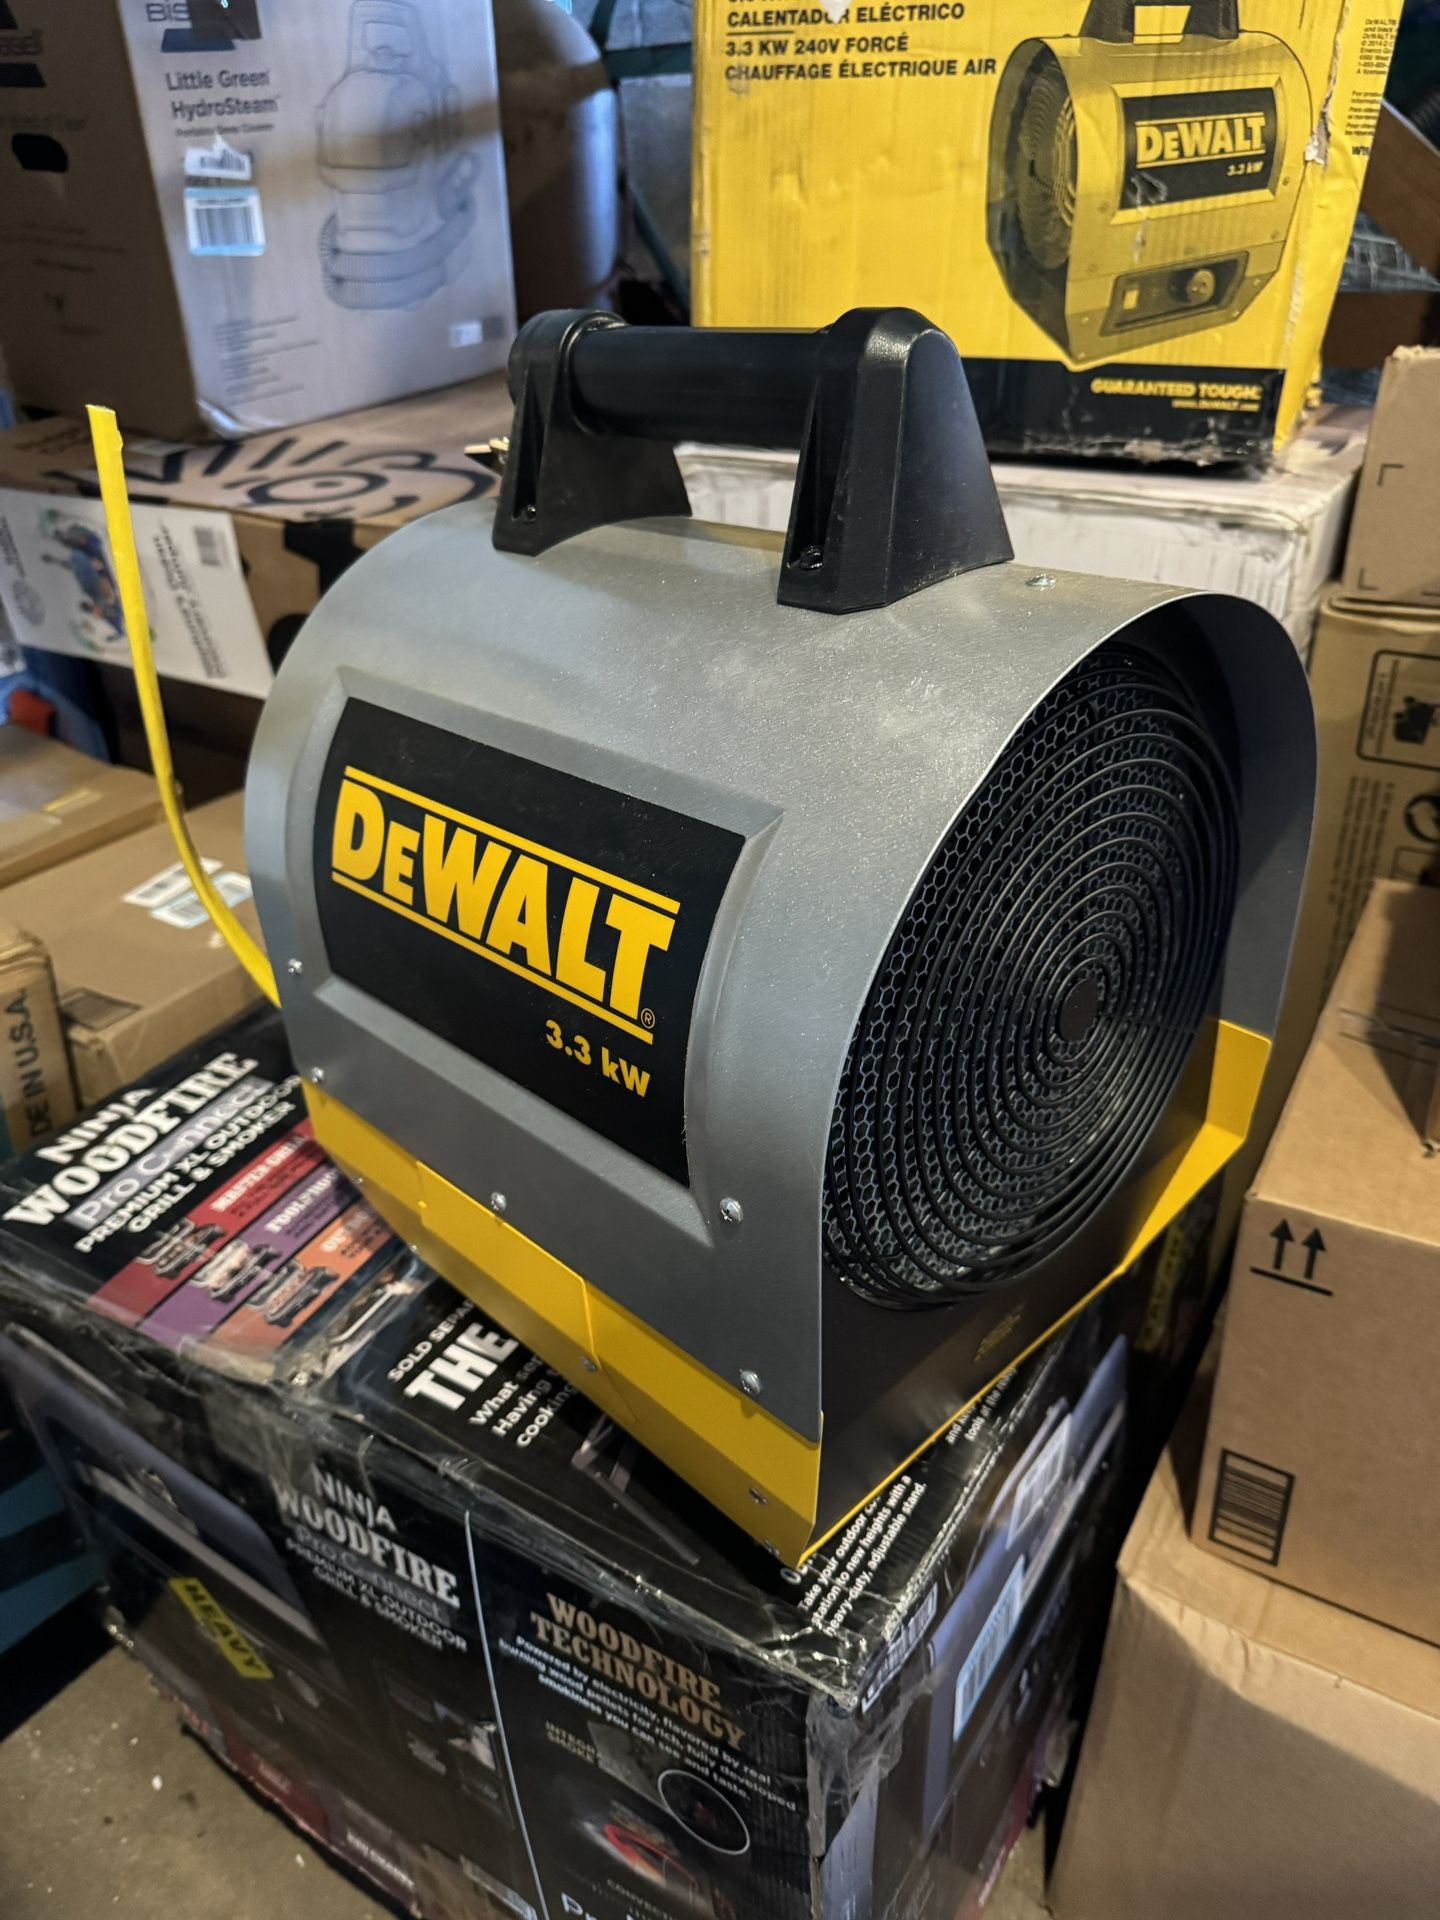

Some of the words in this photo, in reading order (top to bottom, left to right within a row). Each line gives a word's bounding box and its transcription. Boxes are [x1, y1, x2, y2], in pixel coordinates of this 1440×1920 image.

[725, 41, 753, 56] 3.3
[759, 40, 788, 56] KW
[795, 38, 839, 55] 240V
[846, 32, 908, 53] FORCÉ
[857, 3, 965, 23] ELÉCTRICO
[166, 70, 213, 91] Little
[218, 69, 270, 88] Green
[725, 63, 832, 80] CHAUFFAGE
[839, 58, 957, 79] ÉLECTRIQUE
[964, 58, 996, 75] AIR
[172, 97, 279, 121] HydroSteam
[1091, 377, 1196, 398] GUARANTEED
[21, 1068, 46, 1098] IN
[545, 1019, 593, 1067] 3.3
[602, 1046, 651, 1098] kW
[3, 1052, 259, 1226] WOODFIRE
[35, 1087, 158, 1165] NINJA
[74, 1171, 180, 1253] PREMIUM
[174, 1150, 210, 1176] XL
[204, 1074, 302, 1150] OUTDOOR
[127, 1182, 197, 1233] GRILL
[208, 1100, 297, 1168] SMOKER
[75, 1177, 141, 1224] Pro
[387, 1340, 433, 1382] SOLD
[404, 1322, 520, 1412] THE
[468, 1380, 520, 1426] What
[491, 1377, 552, 1437] Having
[516, 1382, 577, 1448] cooking
[964, 1416, 986, 1442] tools
[311, 1463, 398, 1532] NINJA
[867, 1513, 906, 1570] adjustable
[902, 1482, 927, 1516] stand.
[270, 1475, 460, 1609] WOODFIRE
[798, 1584, 821, 1610] Take
[817, 1556, 839, 1585] your
[836, 1513, 867, 1559] outdoor
[811, 1585, 841, 1630] station
[835, 1571, 850, 1586] to
[846, 1546, 866, 1571] new
[859, 1506, 891, 1548] heights
[887, 1483, 906, 1507] with
[901, 1475, 912, 1485] a
[382, 1595, 468, 1652] OUTDOOR
[546, 1592, 722, 1711] WOODFIRE
[516, 1635, 571, 1673] Powered
[573, 1665, 589, 1683] by
[592, 1678, 661, 1724] electricity,
[663, 1715, 719, 1757] flavored
[722, 1751, 740, 1769] by
[743, 1765, 771, 1786] real
[530, 1611, 746, 1751] TECHNOLOGY
[538, 1673, 602, 1716] smokiness
[605, 1710, 629, 1730] you
[631, 1726, 656, 1745] can
[684, 1757, 710, 1776] and
[548, 1667, 584, 1692] wood
[586, 1688, 629, 1717] pellets
[632, 1711, 651, 1729] for
[687, 1743, 716, 1768] fully
[720, 1764, 796, 1812] developed
